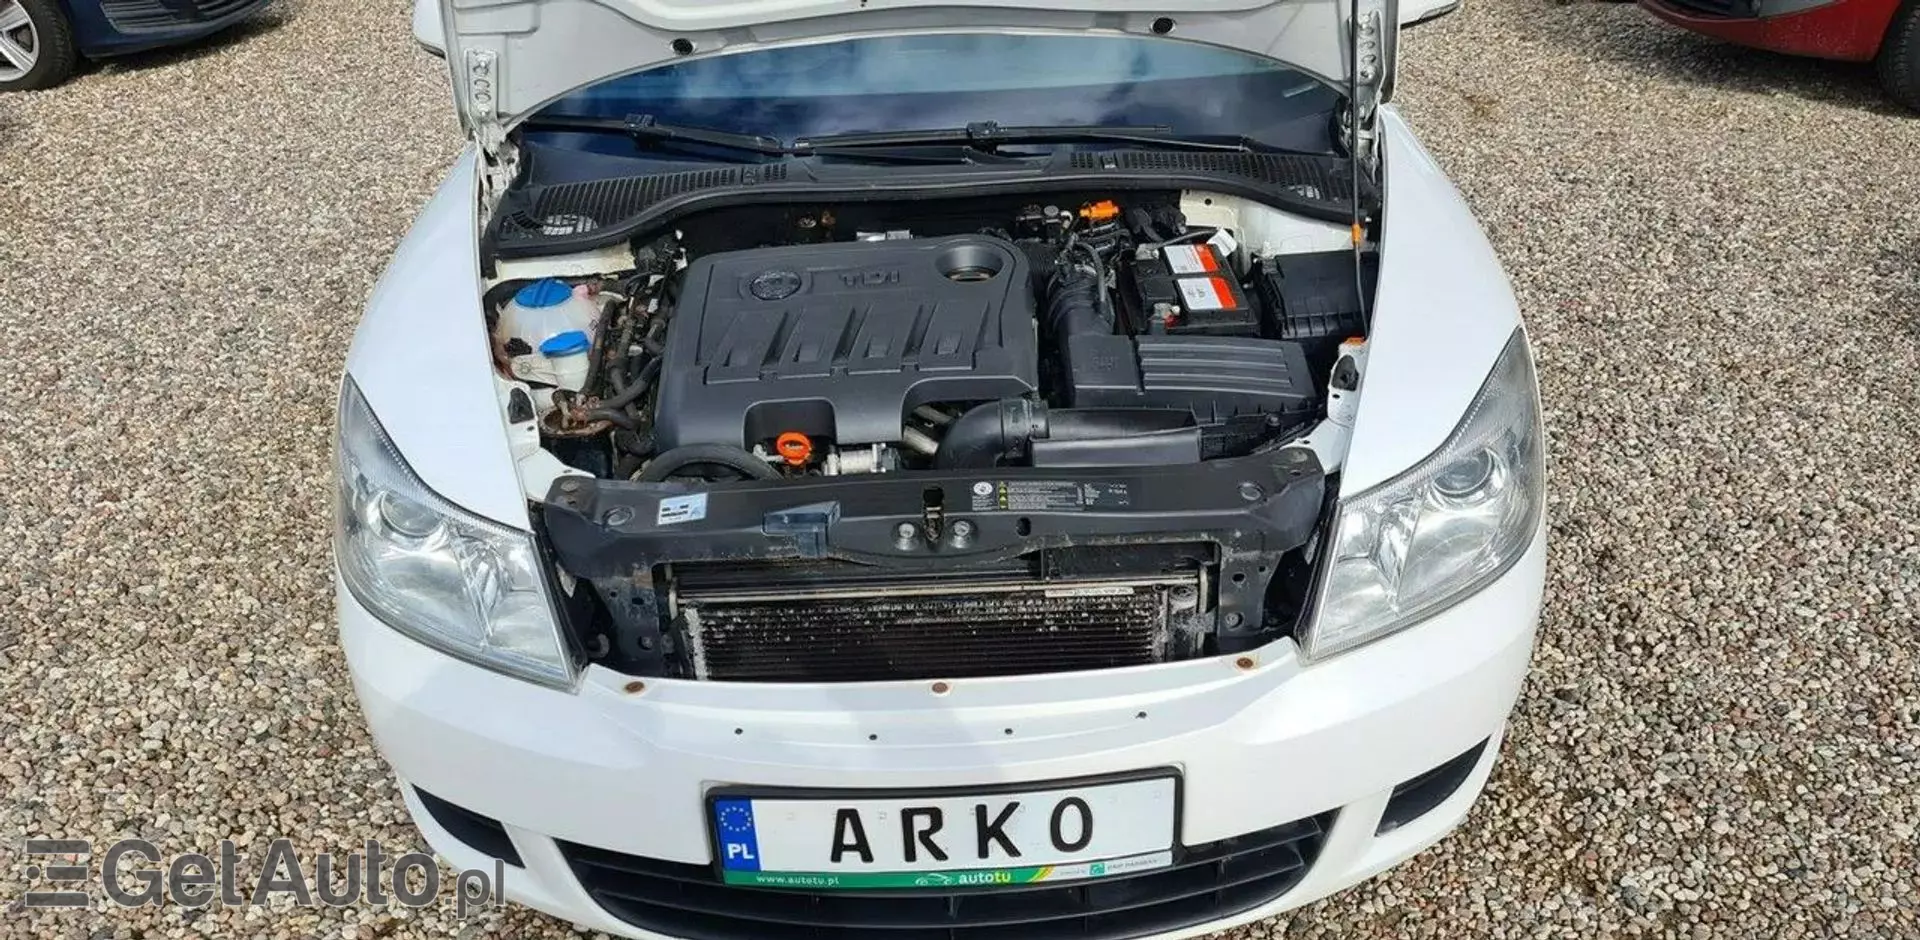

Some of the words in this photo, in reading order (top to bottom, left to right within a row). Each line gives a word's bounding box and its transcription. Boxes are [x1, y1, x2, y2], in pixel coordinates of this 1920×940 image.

[838, 270, 901, 288] TDI
[830, 796, 1095, 863] ARKO
[727, 843, 755, 860] PL
[756, 875, 840, 888] www.autotu.pl
[958, 872, 1012, 884] autotu
